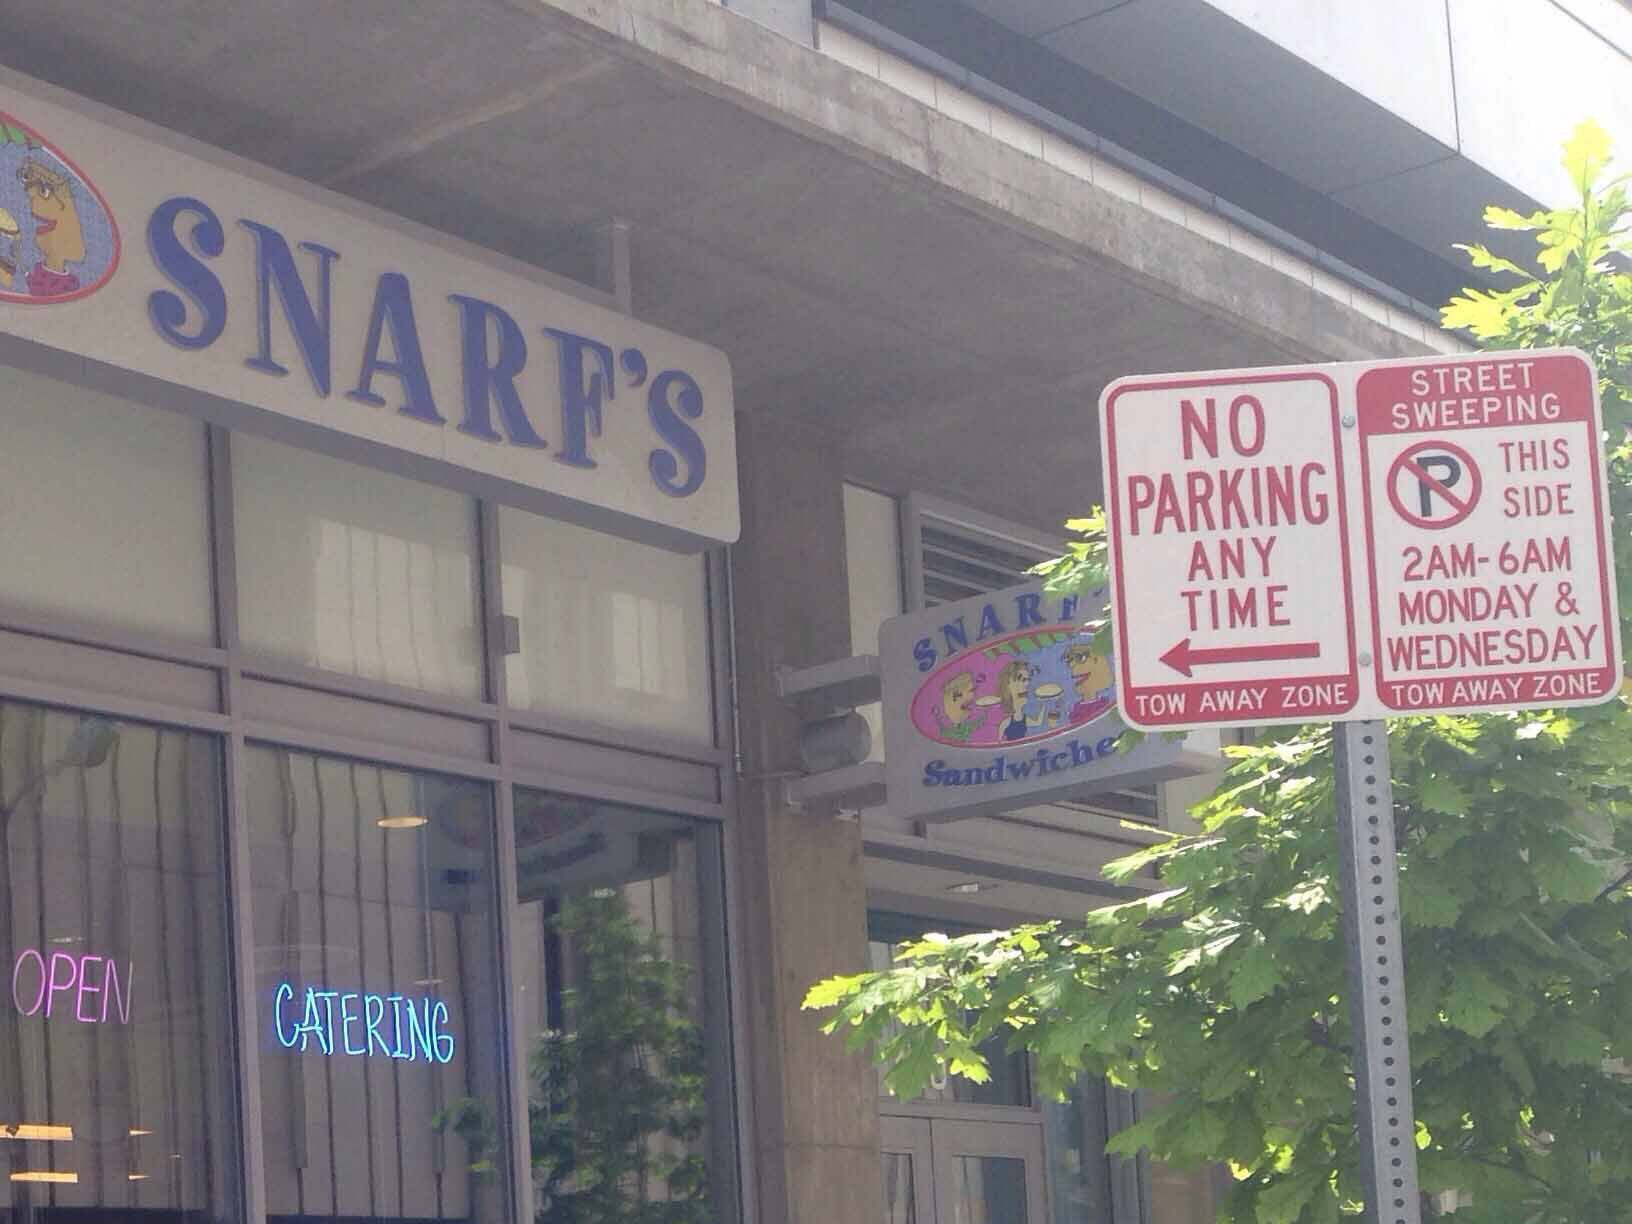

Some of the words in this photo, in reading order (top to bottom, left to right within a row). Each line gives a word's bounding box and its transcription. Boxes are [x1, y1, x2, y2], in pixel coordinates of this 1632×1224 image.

[146, 197, 707, 499] SNARF'S
[1411, 362, 1534, 396] STREET
[1180, 394, 1266, 460] NO
[1391, 392, 1561, 430] SWEEPING
[1498, 439, 1571, 473] THIS
[1127, 462, 1329, 537] PARKING
[1503, 484, 1575, 518] SIDE
[1188, 535, 1277, 582] ANY
[1181, 584, 1291, 632] TIME
[1398, 583, 1538, 626] MONDAY
[1554, 581, 1580, 616] &
[913, 587, 1105, 673] SNARF'
[1387, 624, 1598, 672] WEDNESDAY
[1135, 692, 1195, 717] TOW
[1199, 687, 1269, 713] AWAY
[1282, 682, 1350, 707] ZONE
[1391, 681, 1442, 707] TOW
[1452, 677, 1525, 704] AWAY
[1533, 673, 1603, 698] ZONE
[922, 735, 1117, 788] Sandwiche
[13, 949, 133, 1025] OPEN
[274, 983, 455, 1064] CATERING
